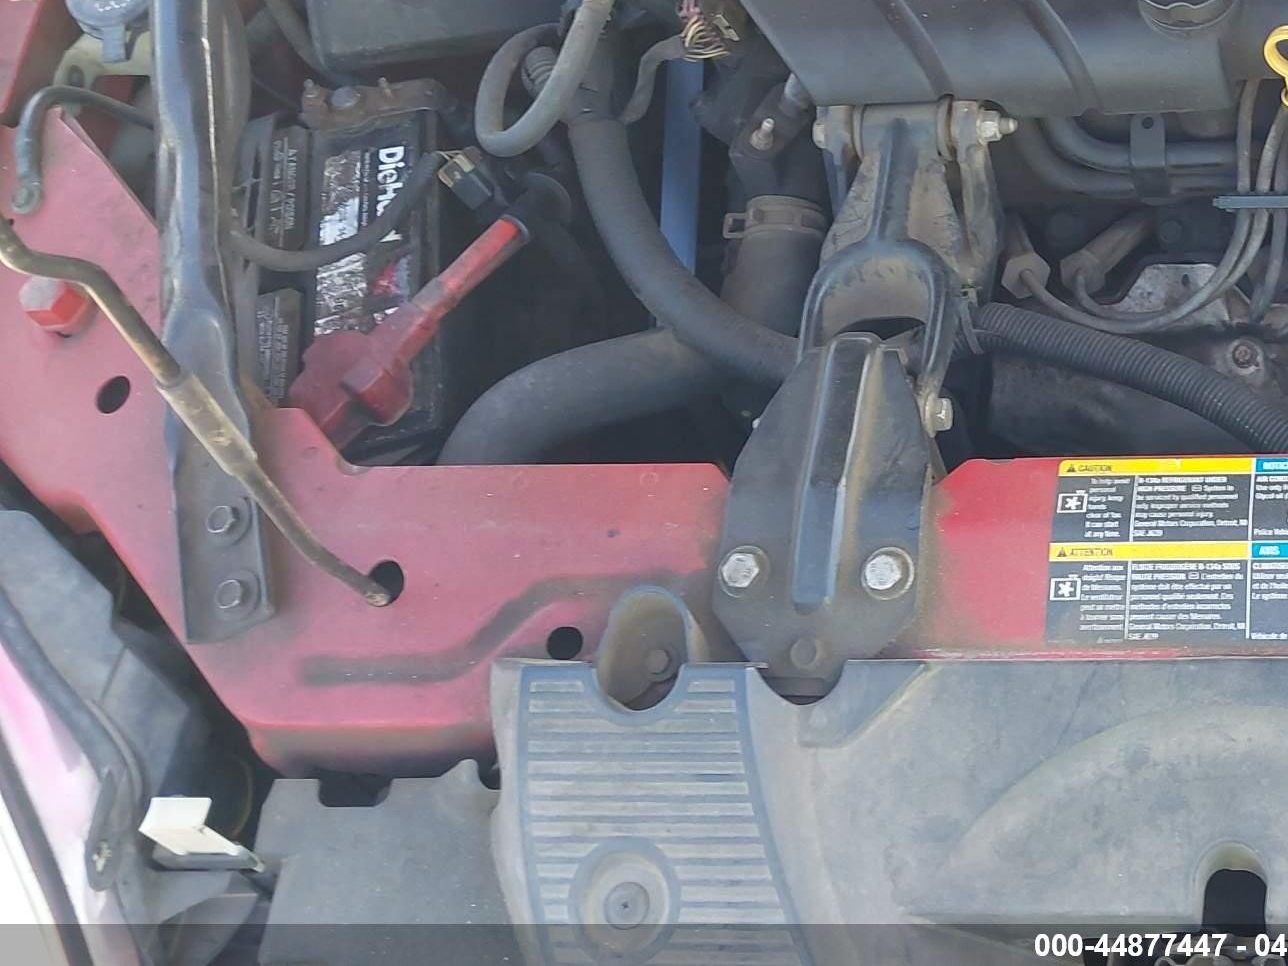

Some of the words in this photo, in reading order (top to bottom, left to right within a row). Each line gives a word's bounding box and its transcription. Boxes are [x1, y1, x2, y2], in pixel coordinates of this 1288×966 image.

[1078, 464, 1112, 472] CAUTION
[1071, 548, 1113, 556] ATTENTION
[1259, 546, 1280, 554] AVIS
